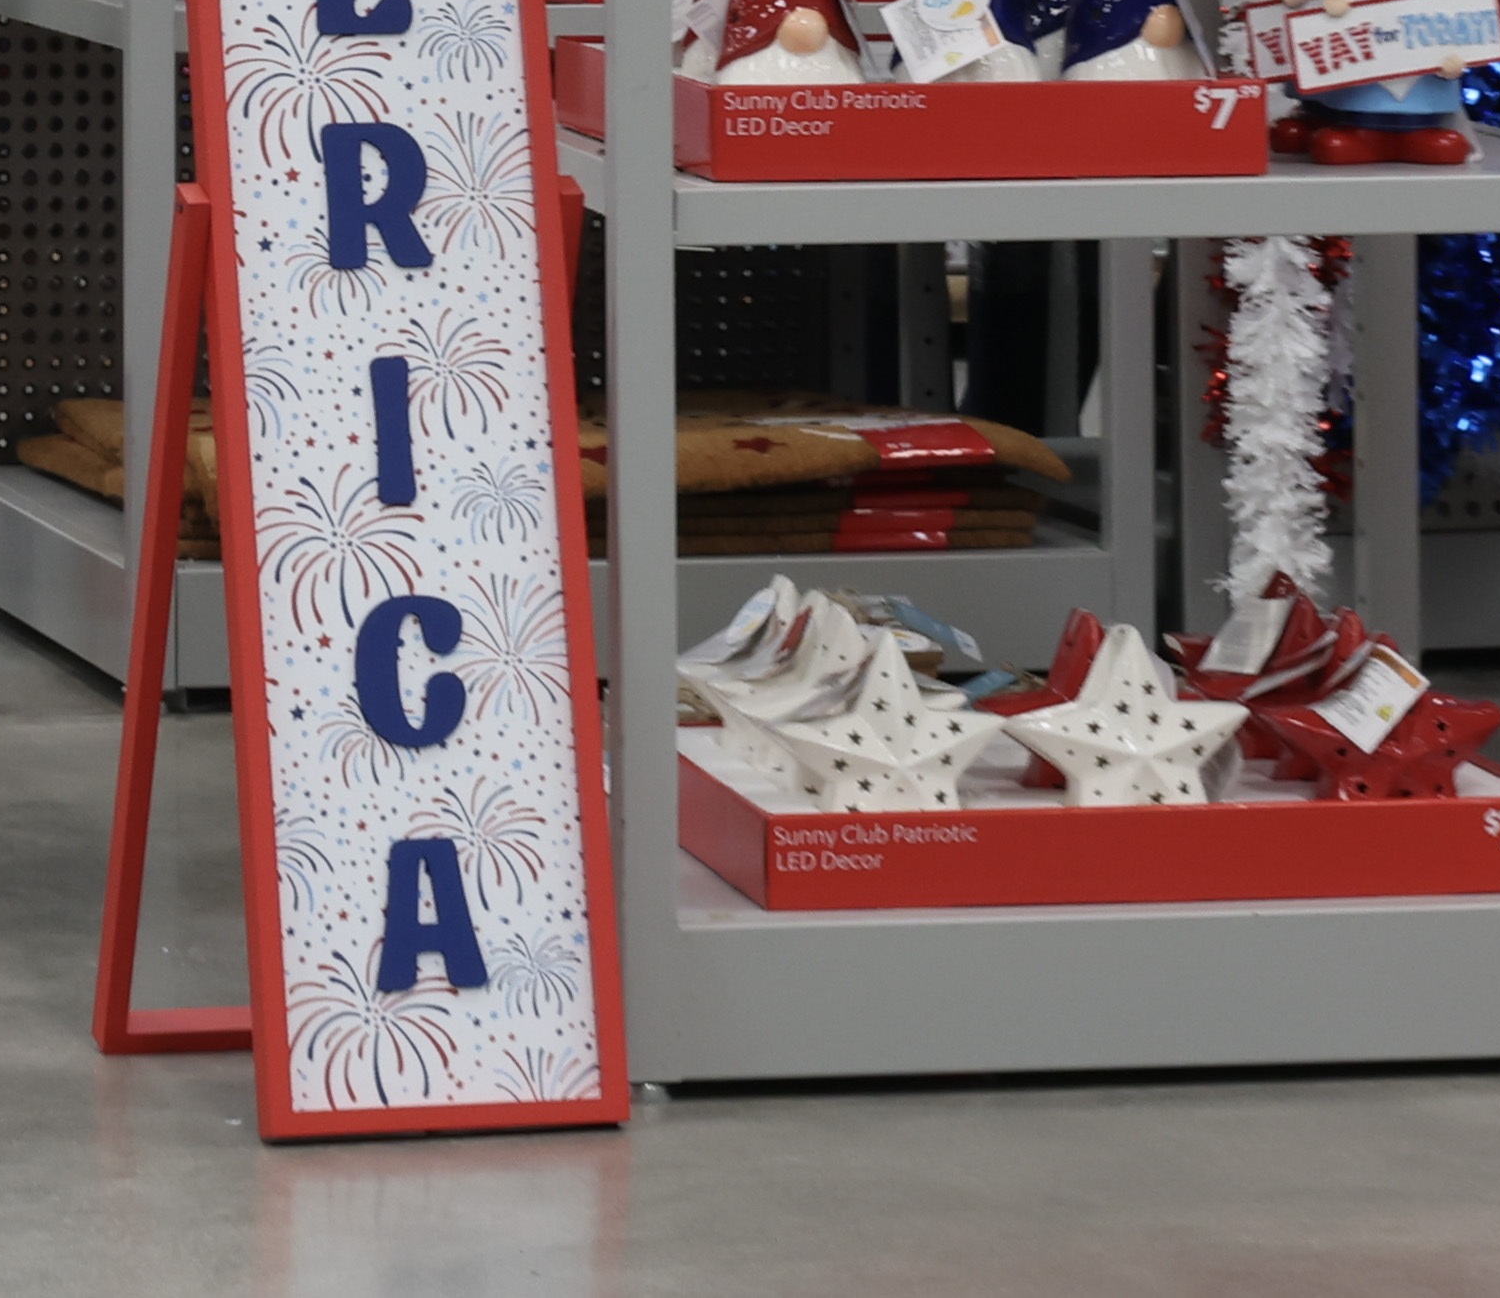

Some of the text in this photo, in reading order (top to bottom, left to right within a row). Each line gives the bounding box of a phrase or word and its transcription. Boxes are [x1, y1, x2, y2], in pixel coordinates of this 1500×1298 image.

[1298, 22, 1375, 75] YAY
[1373, 27, 1399, 43] for
[723, 91, 787, 114] Sunny
[791, 91, 838, 110] Club
[842, 90, 926, 110] Patriotic
[726, 117, 834, 136] LED Decor
[773, 826, 838, 849] Sunny
[841, 823, 890, 844] Club
[892, 823, 979, 844] Patriotic
[776, 850, 884, 872] LED Decor
